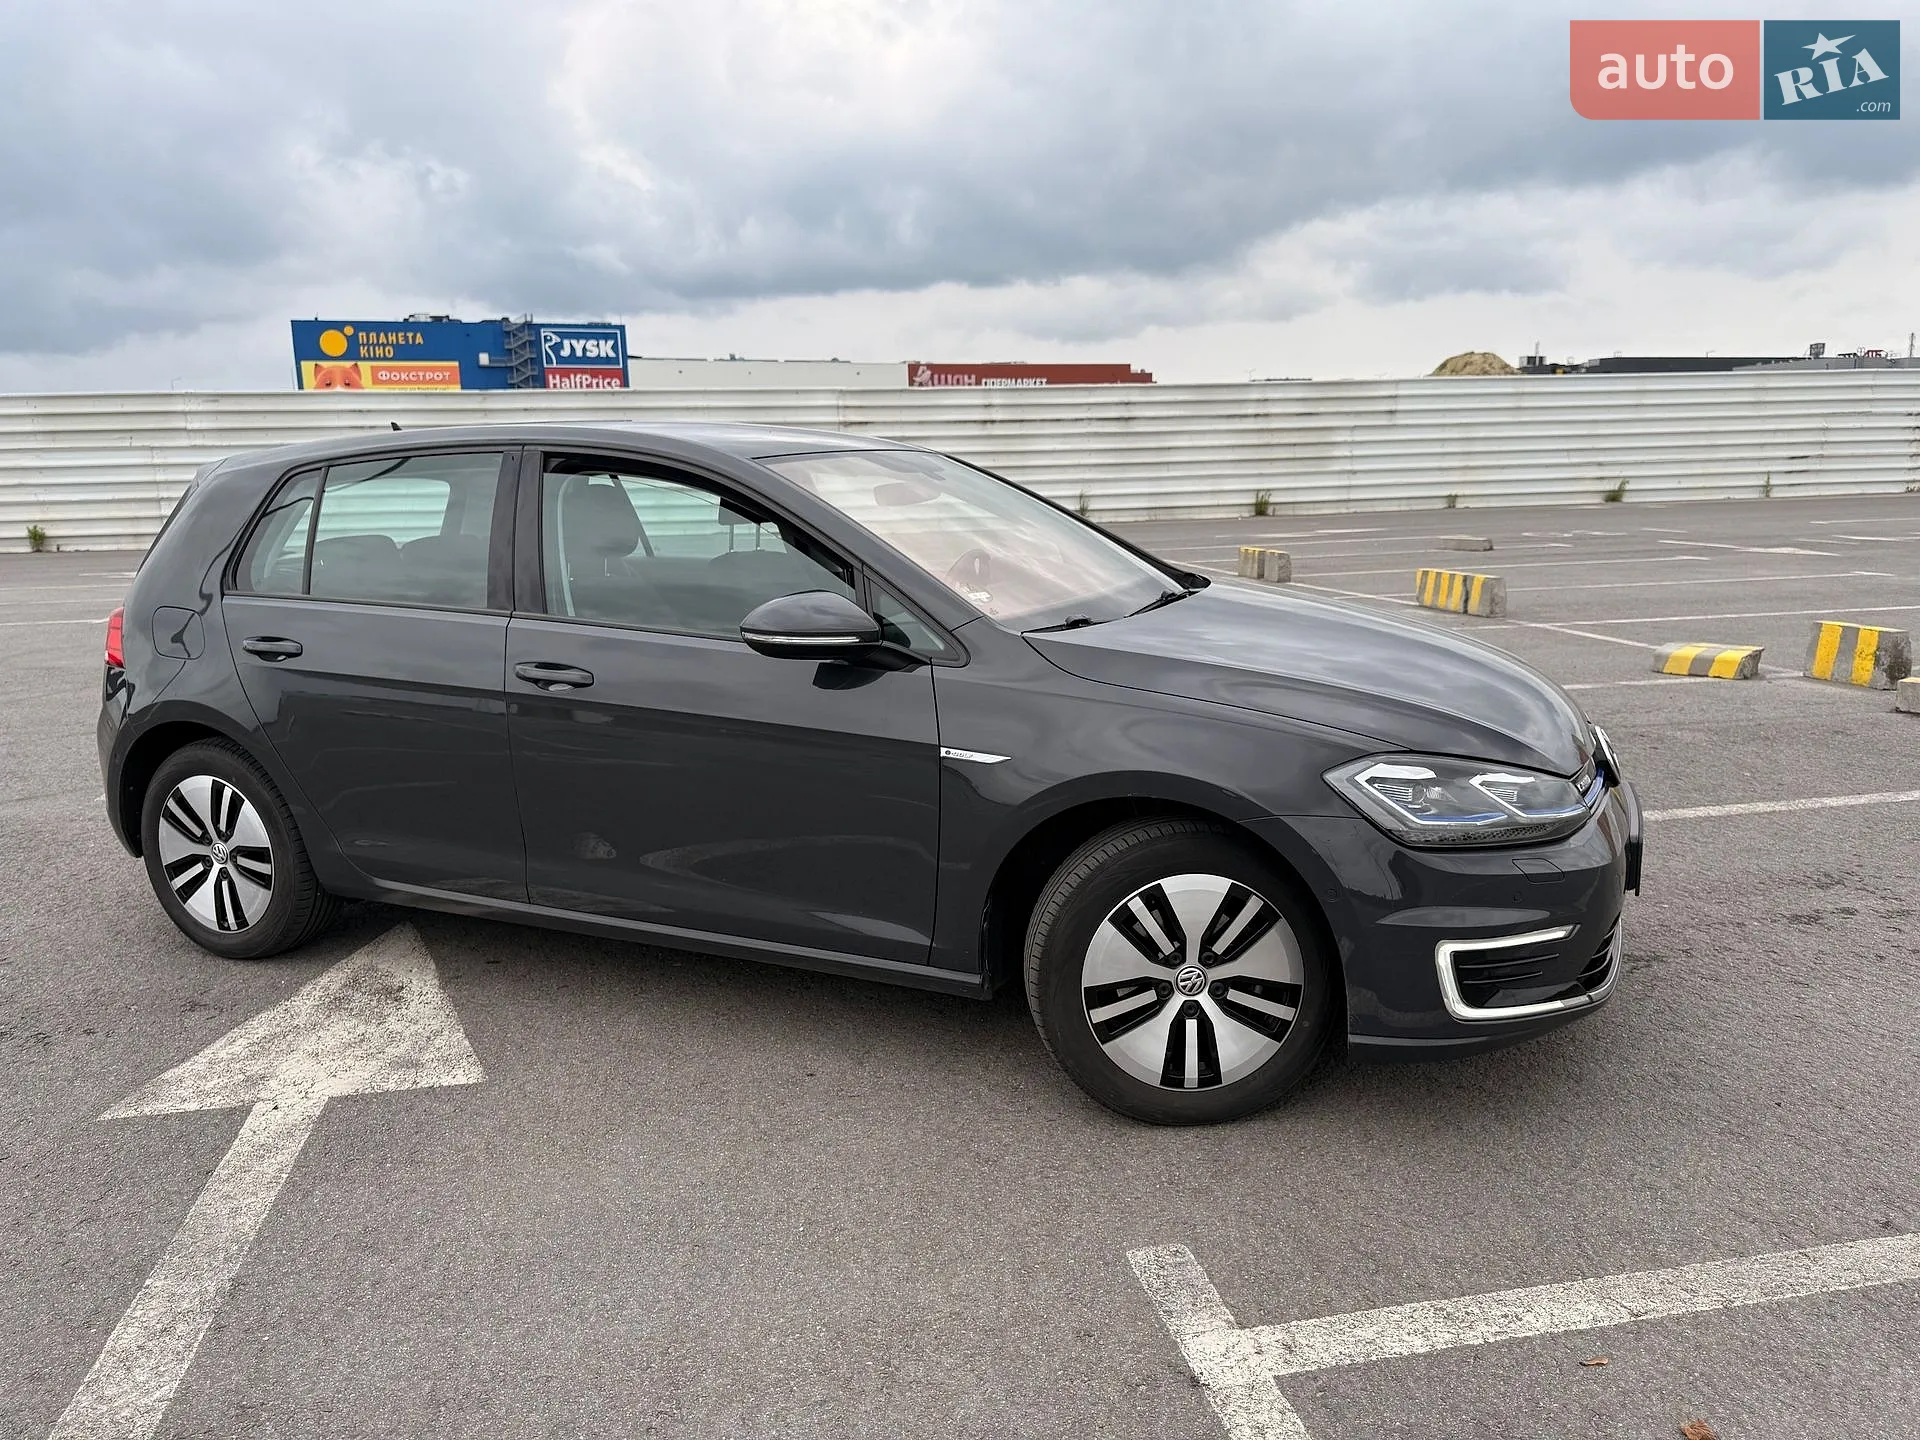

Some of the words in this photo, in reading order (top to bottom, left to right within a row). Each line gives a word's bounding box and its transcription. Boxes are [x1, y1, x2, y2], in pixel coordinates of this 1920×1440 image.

[358, 331, 424, 345] ПЛАНЕТА
[359, 345, 394, 358] КІНО
[559, 339, 617, 358] JYSK
[548, 373, 621, 390] HalfPrice
